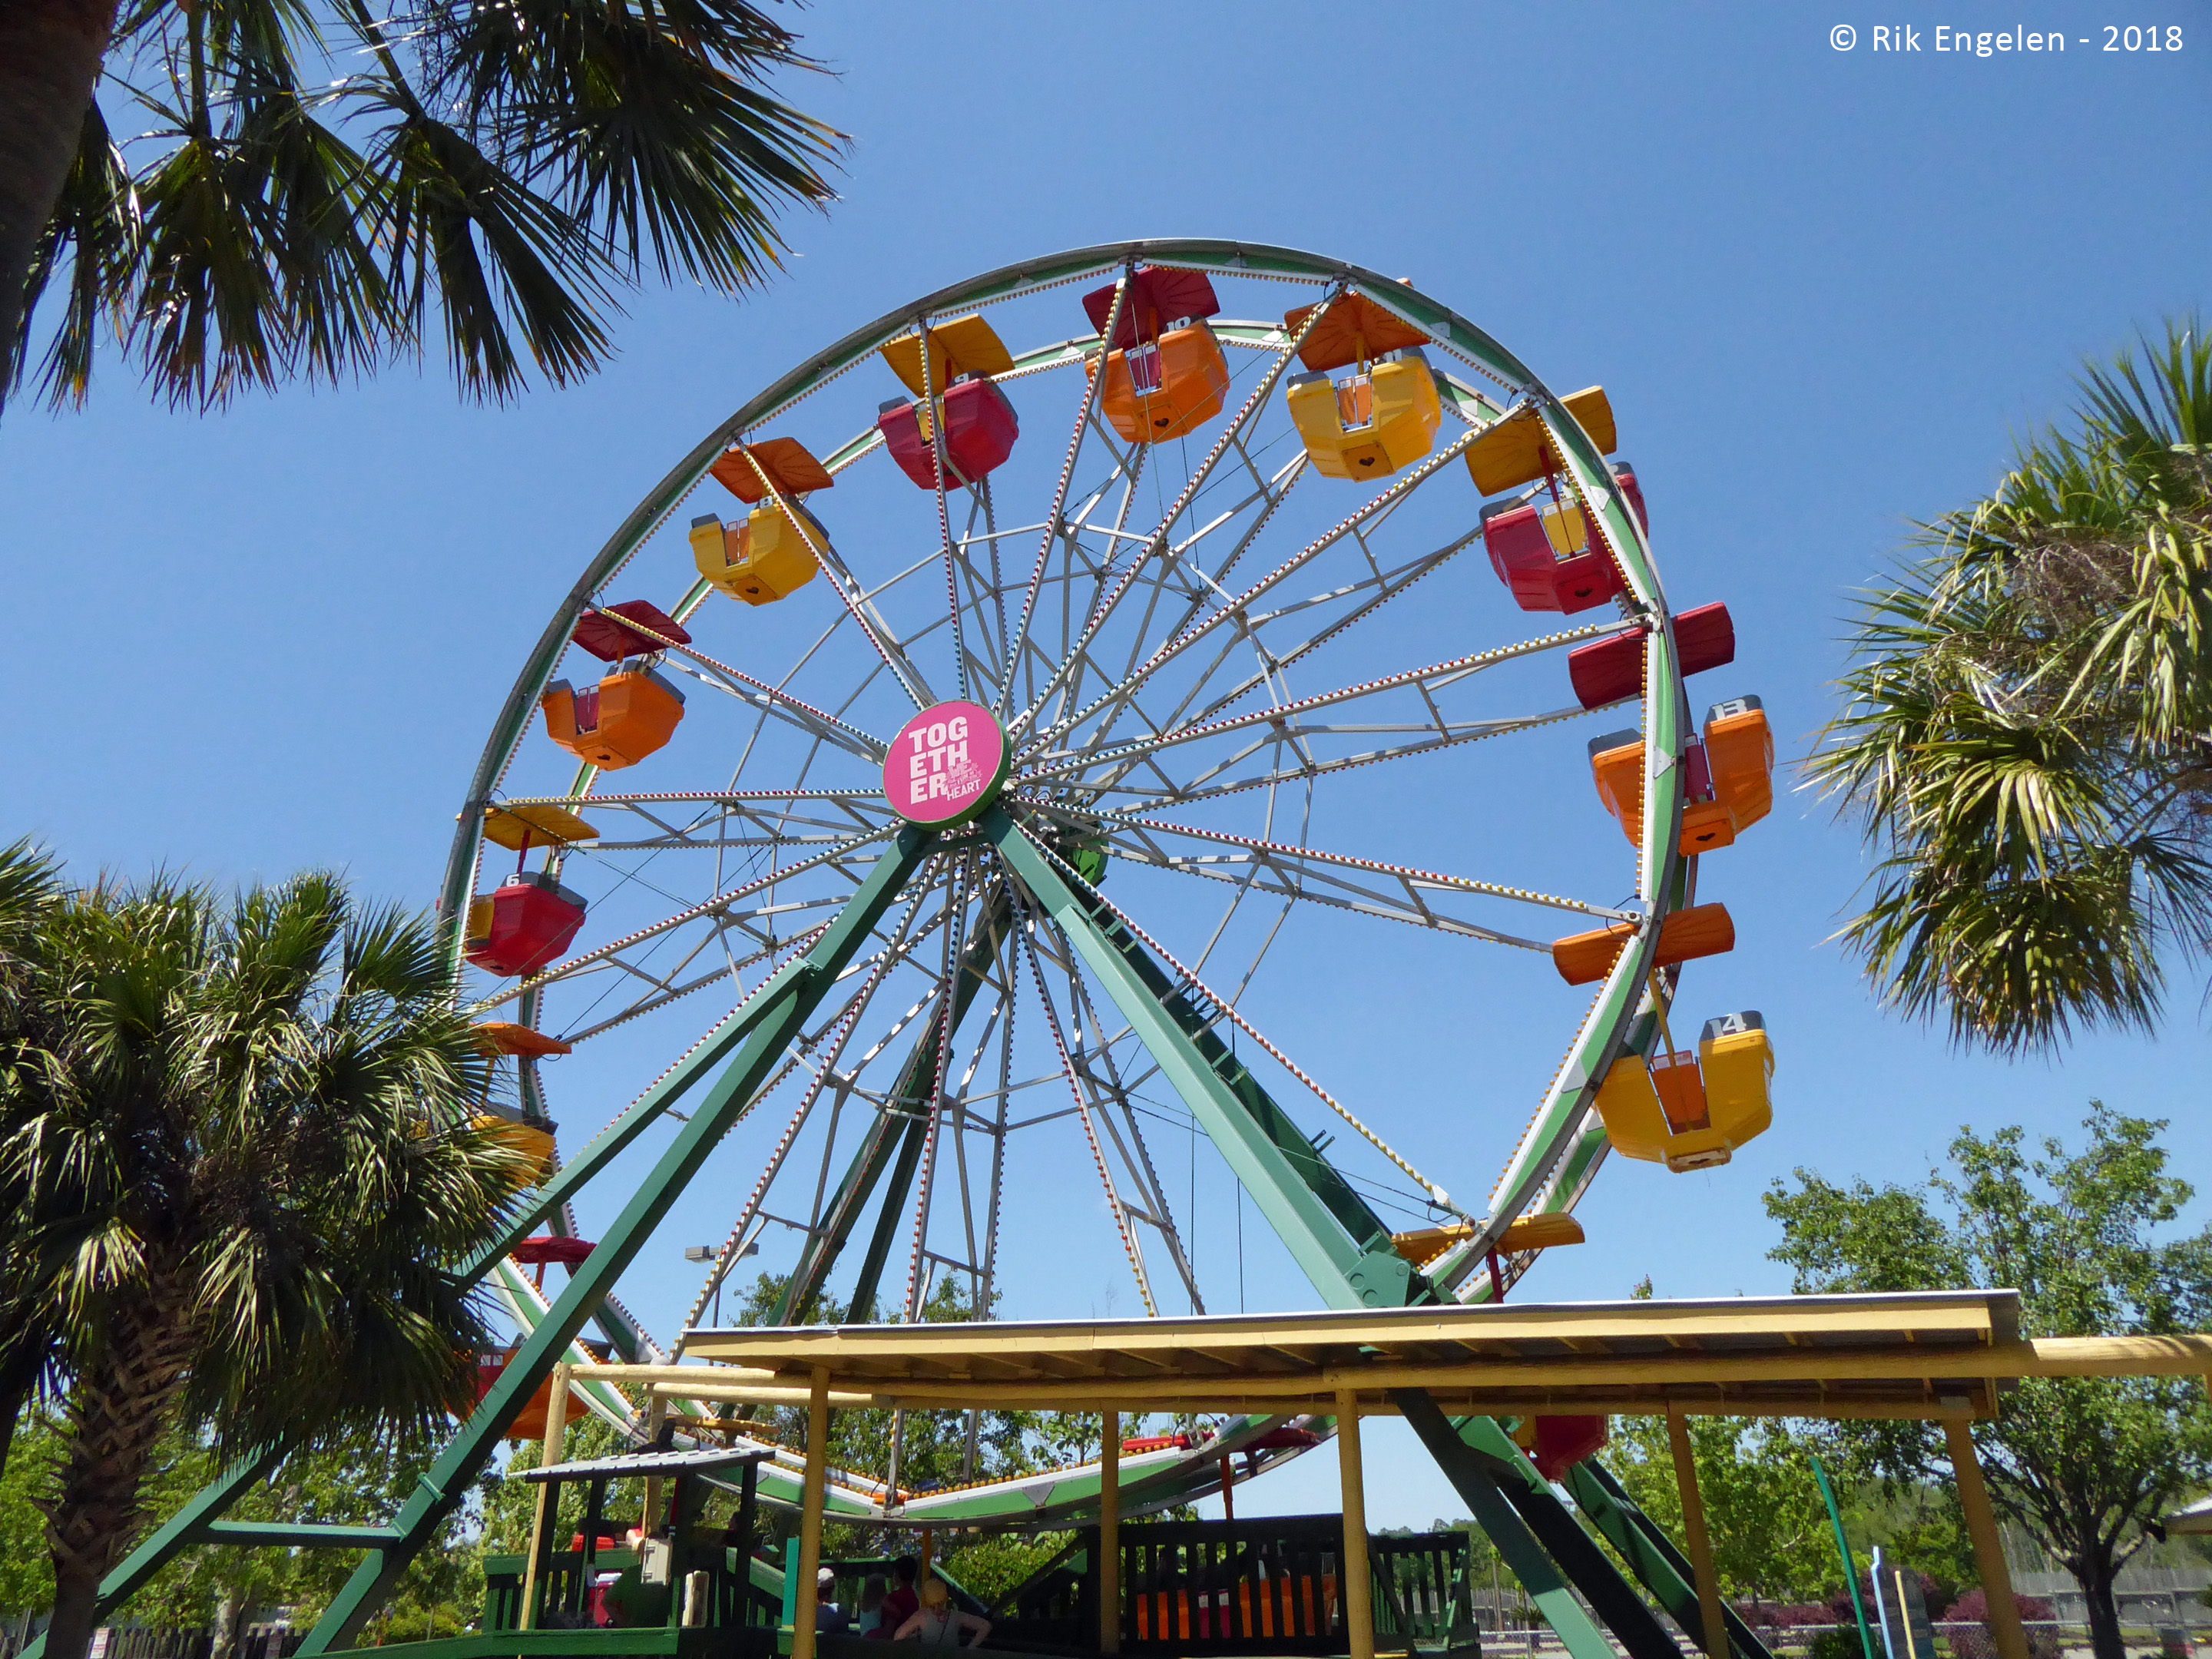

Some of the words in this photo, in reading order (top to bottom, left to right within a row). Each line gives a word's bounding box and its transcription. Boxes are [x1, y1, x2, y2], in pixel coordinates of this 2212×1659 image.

[1167, 316, 1190, 333] 10
[1384, 349, 1402, 363] 11
[955, 373, 969, 387] 9
[1712, 699, 1747, 720] 13
[909, 716, 968, 753] TOG
[910, 740, 968, 779] ETH
[911, 772, 949, 804] ER
[947, 779, 981, 801] HEART
[506, 873, 520, 887] 6
[1709, 1013, 1747, 1036] 14
